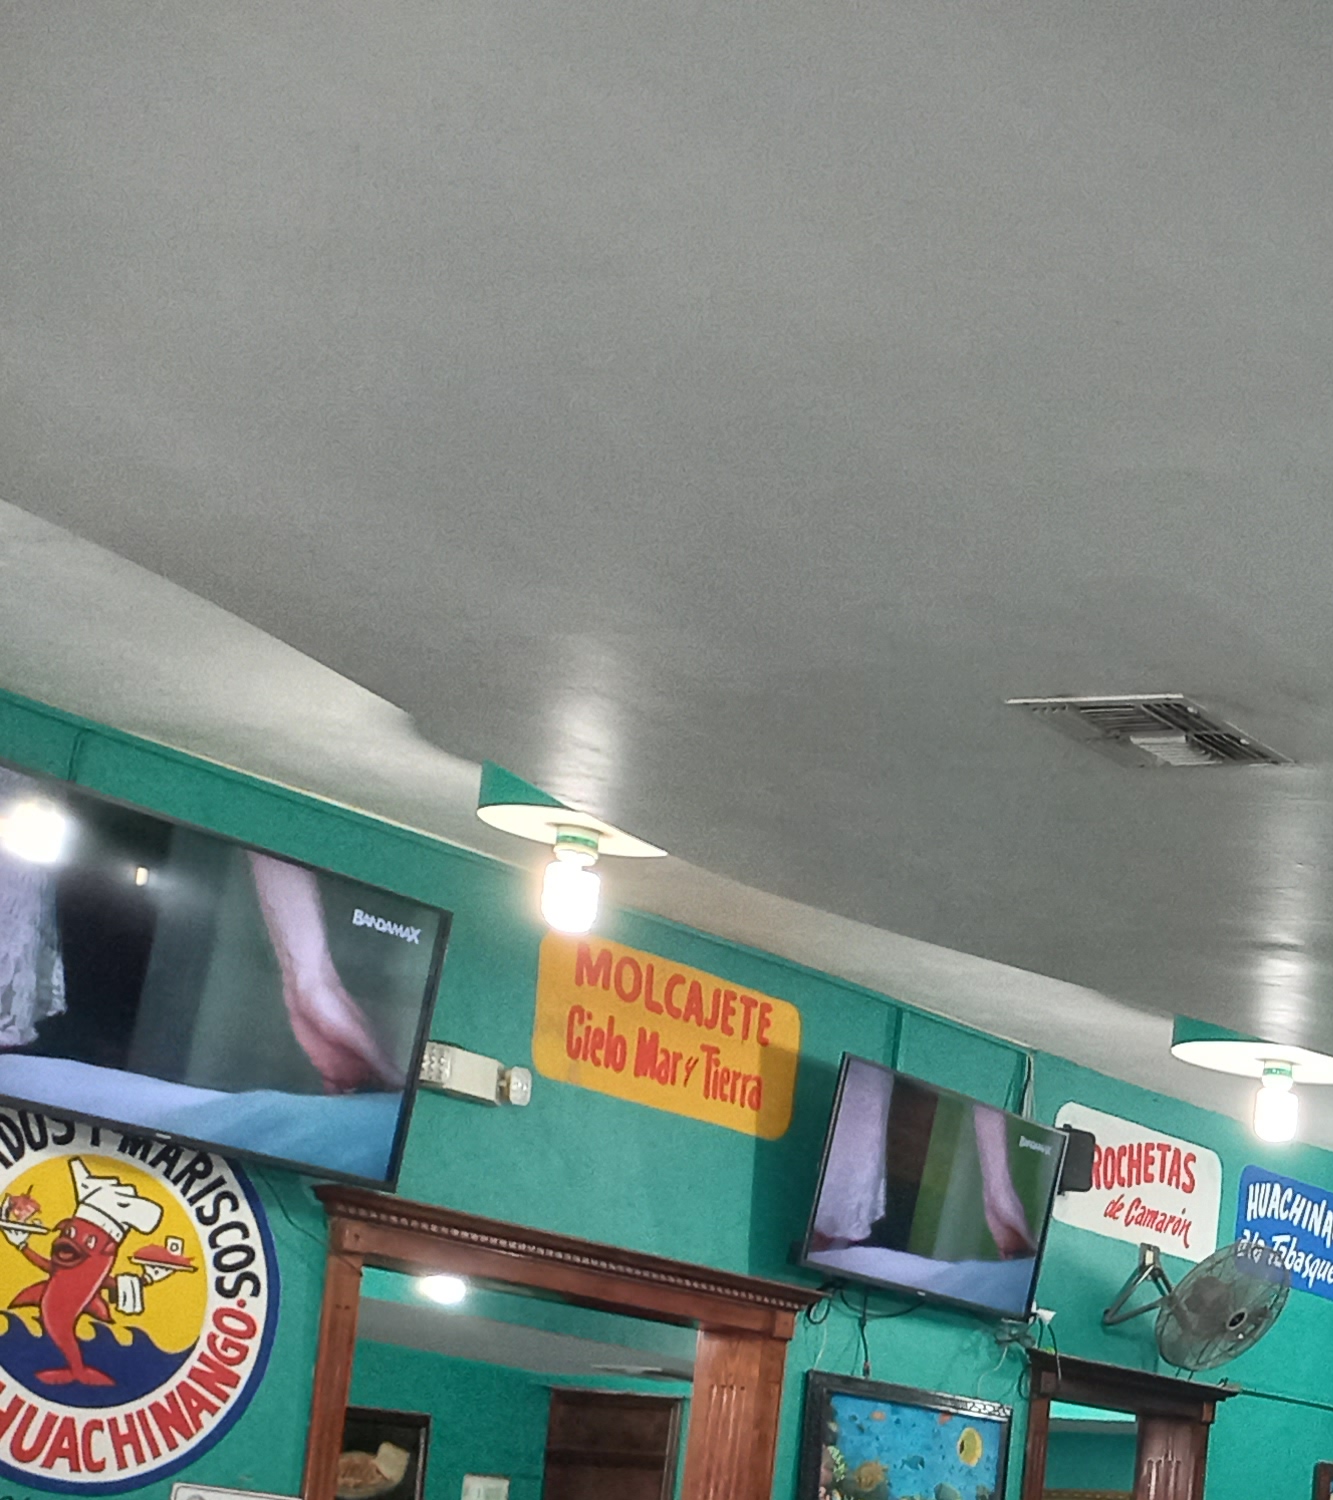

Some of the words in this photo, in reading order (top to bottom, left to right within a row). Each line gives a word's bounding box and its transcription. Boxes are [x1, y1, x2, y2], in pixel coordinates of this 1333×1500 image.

[574, 942, 773, 1047] MOLCAJETE
[566, 1004, 627, 1073] Cielo
[633, 1026, 683, 1086] Mar
[700, 1043, 763, 1111] Tierra
[1092, 1142, 1197, 1194] ROCHETAS
[1103, 1193, 1125, 1220] de
[1124, 1197, 1192, 1249] Camarón
